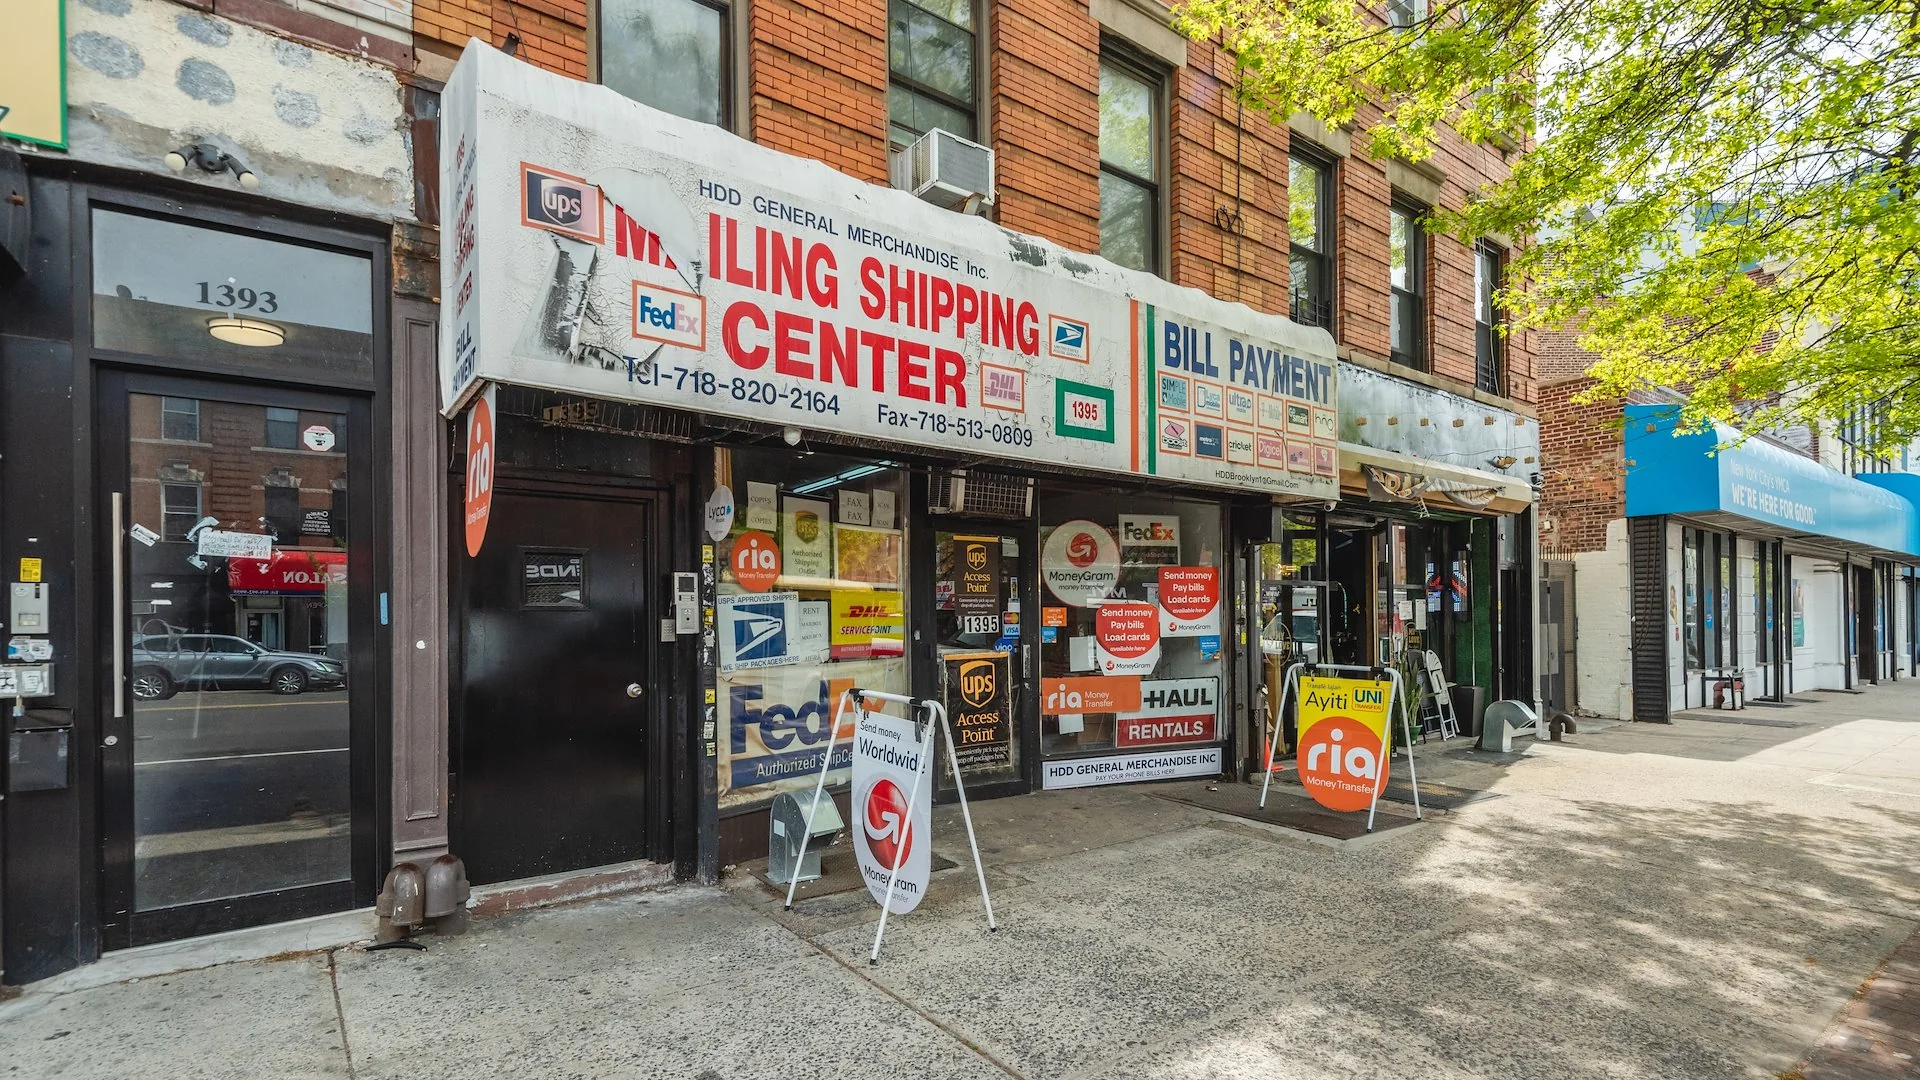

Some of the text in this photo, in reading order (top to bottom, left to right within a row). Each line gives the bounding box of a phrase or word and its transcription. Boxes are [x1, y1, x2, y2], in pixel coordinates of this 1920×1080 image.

[543, 190, 582, 219] ups
[700, 179, 990, 281] HDD GENERAL MERCHANDISE Inc.
[615, 204, 1040, 357] MILING SHIPPING
[196, 280, 279, 314] 1393
[640, 294, 699, 336] FedEx
[721, 300, 968, 409] CENTER
[1165, 320, 1331, 405] BILL PAYMENT
[1072, 400, 1099, 422] 1395
[877, 403, 1033, 448] Fax-718-513-0809
[1229, 440, 1252, 452] cricket
[468, 421, 490, 504] ria
[1730, 457, 1744, 477] New
[1744, 463, 1758, 482] York
[847, 497, 863, 508] FAX
[1731, 481, 1816, 525] WE'RE HERE FOR GOOD.
[708, 505, 726, 521] Lyca
[750, 516, 773, 525] COPIES
[847, 511, 863, 521] FAX
[1124, 521, 1175, 541] FedEx
[738, 538, 776, 570] ria
[791, 549, 823, 559] Authorized
[967, 551, 986, 567] ups
[794, 558, 819, 568] Shipping
[738, 571, 776, 580] Money Transfer
[963, 571, 991, 583] Access
[1049, 570, 1114, 583] MoneyGram
[1164, 571, 1213, 582] Send money
[966, 583, 988, 594] Point
[1058, 584, 1080, 592] money
[1172, 582, 1205, 593] Pay bills
[718, 593, 798, 605] USPS APPROVED SHIPPER
[1167, 594, 1211, 604] Load cards
[802, 607, 820, 615] RENT
[848, 605, 890, 618] DHL
[1102, 608, 1153, 619] Send money
[840, 625, 892, 635] SERVICEPOINT
[966, 616, 998, 633] 1395
[1005, 626, 1019, 634] VISA
[1110, 619, 1145, 630] Pay bills
[1178, 623, 1211, 631] MoneyGram
[1105, 632, 1151, 642] Load cards
[722, 655, 801, 671] WE SHIP PACKAGES HERE
[1115, 662, 1151, 670] MoneyGram
[964, 674, 993, 701] ups
[1085, 690, 1110, 700] Money
[1047, 683, 1082, 710] ria
[1085, 699, 1114, 708] Transfer
[1143, 687, 1213, 709] -HAUL
[1305, 691, 1347, 712] Ayiti
[1354, 689, 1382, 704] UNI
[956, 711, 999, 727] Access
[860, 720, 902, 743] Send money
[961, 727, 993, 744] Point
[1128, 720, 1204, 740] RENTALS
[956, 748, 982, 757] onveniently
[982, 746, 993, 754] pick
[1306, 728, 1376, 781] ria
[756, 756, 816, 778] Authorized
[1049, 753, 1216, 777] HDD GENERAL MERCHANDISE INC
[1124, 771, 1145, 779] PHONE
[1306, 775, 1375, 794] Money Transfer
[864, 864, 917, 894] Moneyram
